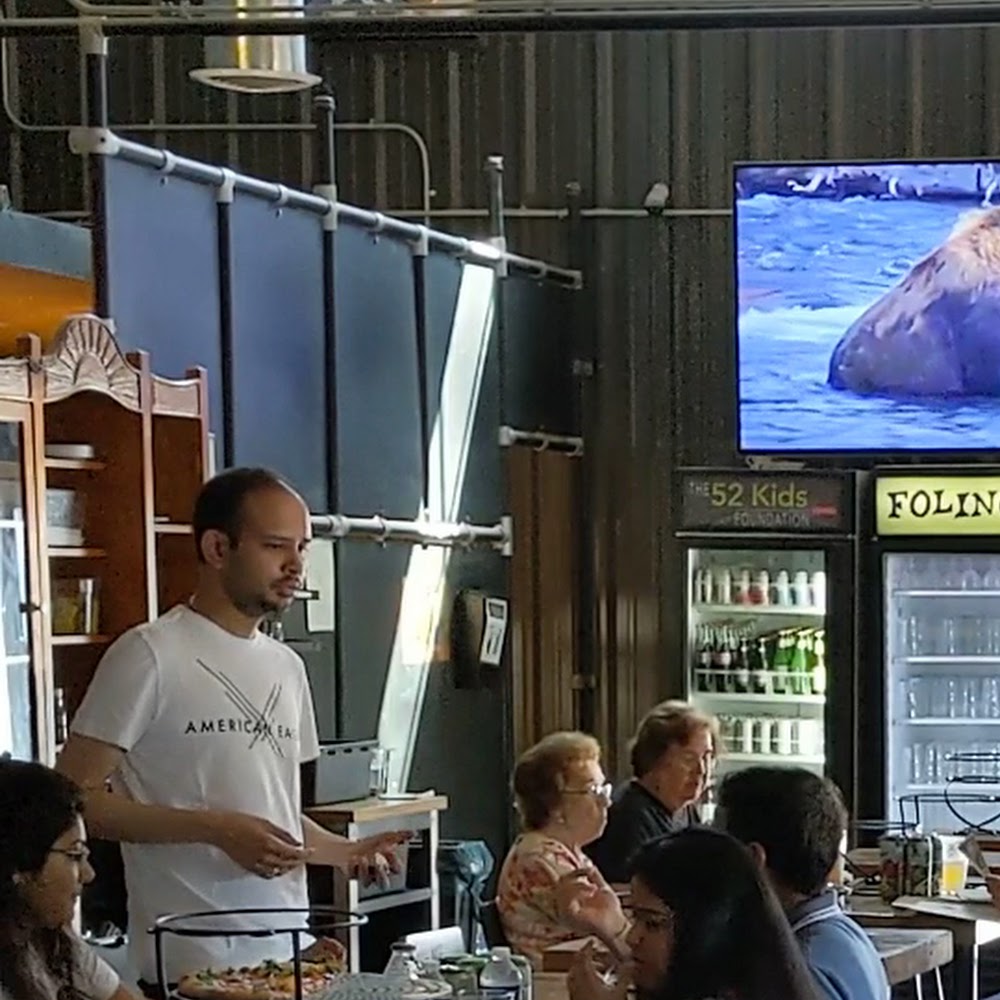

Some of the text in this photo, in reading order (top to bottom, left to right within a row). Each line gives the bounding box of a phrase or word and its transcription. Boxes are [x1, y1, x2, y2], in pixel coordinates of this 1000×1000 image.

[710, 482, 743, 508] 52
[751, 482, 808, 508] Kids
[733, 510, 811, 528] FOUNDATION
[184, 718, 273, 738] AMERICAN
